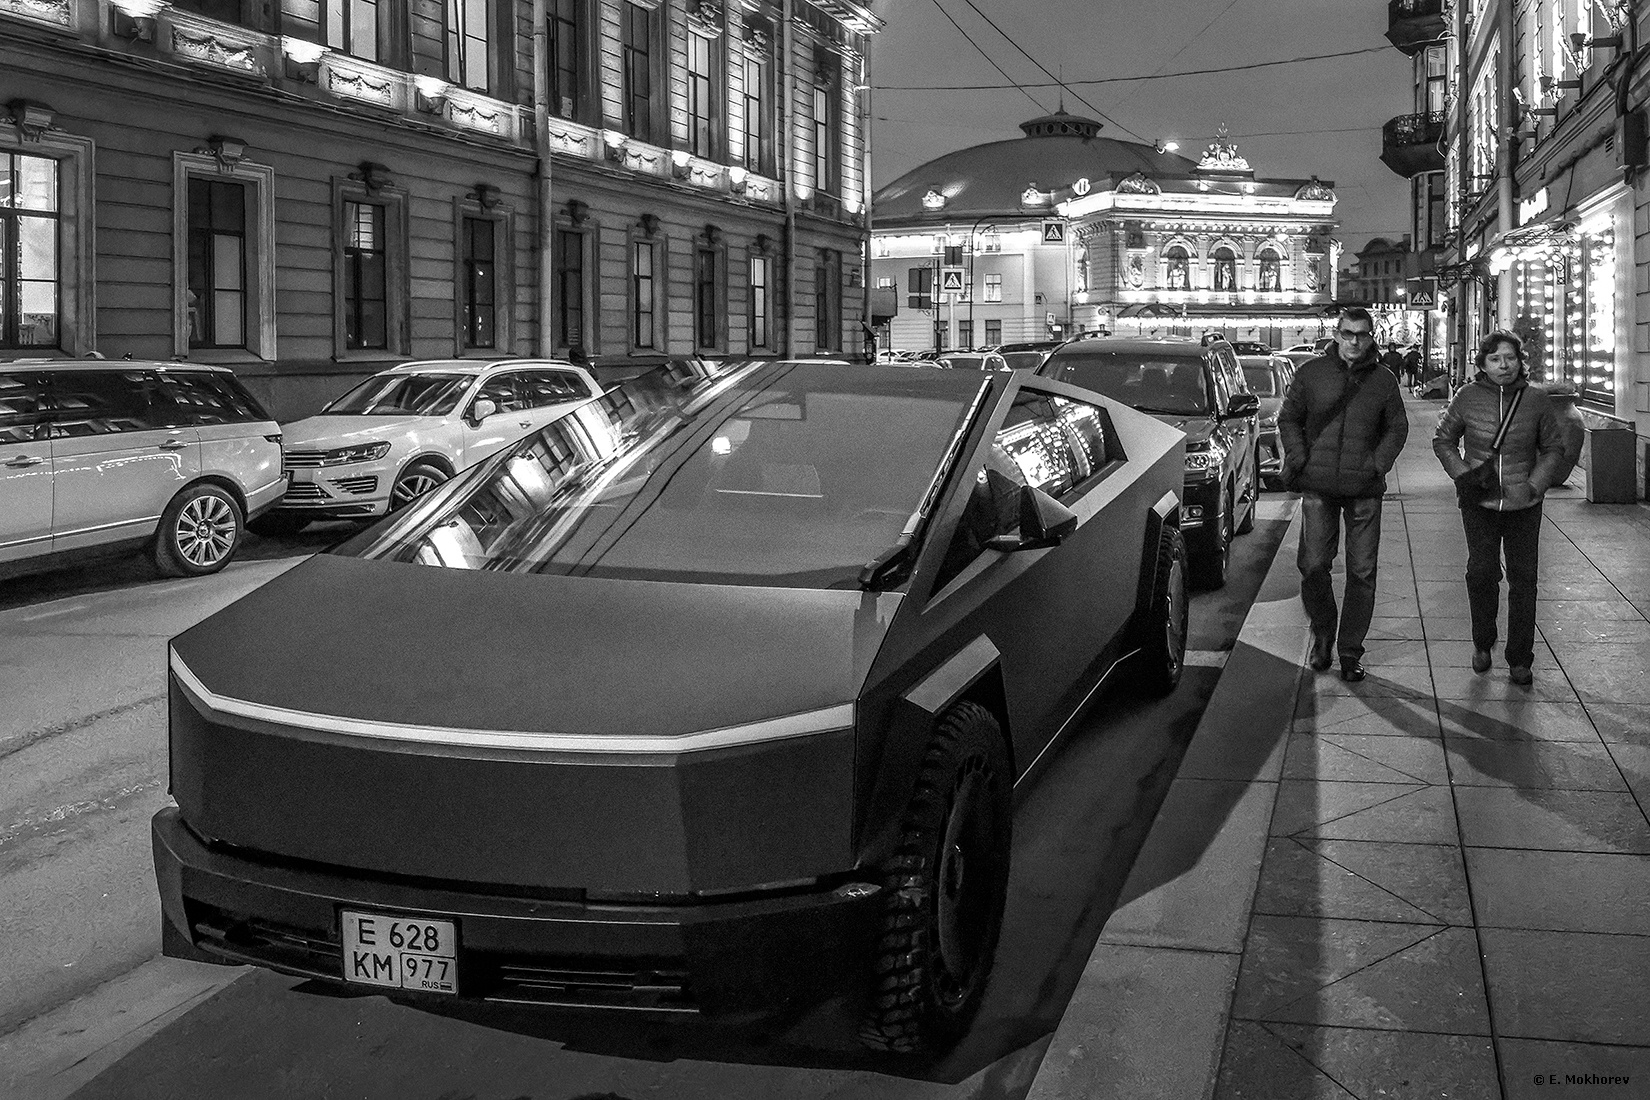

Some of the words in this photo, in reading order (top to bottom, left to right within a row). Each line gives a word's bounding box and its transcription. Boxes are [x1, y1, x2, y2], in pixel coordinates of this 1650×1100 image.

[389, 922, 440, 952] 628
[406, 958, 449, 980] 977
[421, 980, 440, 989] RUS
